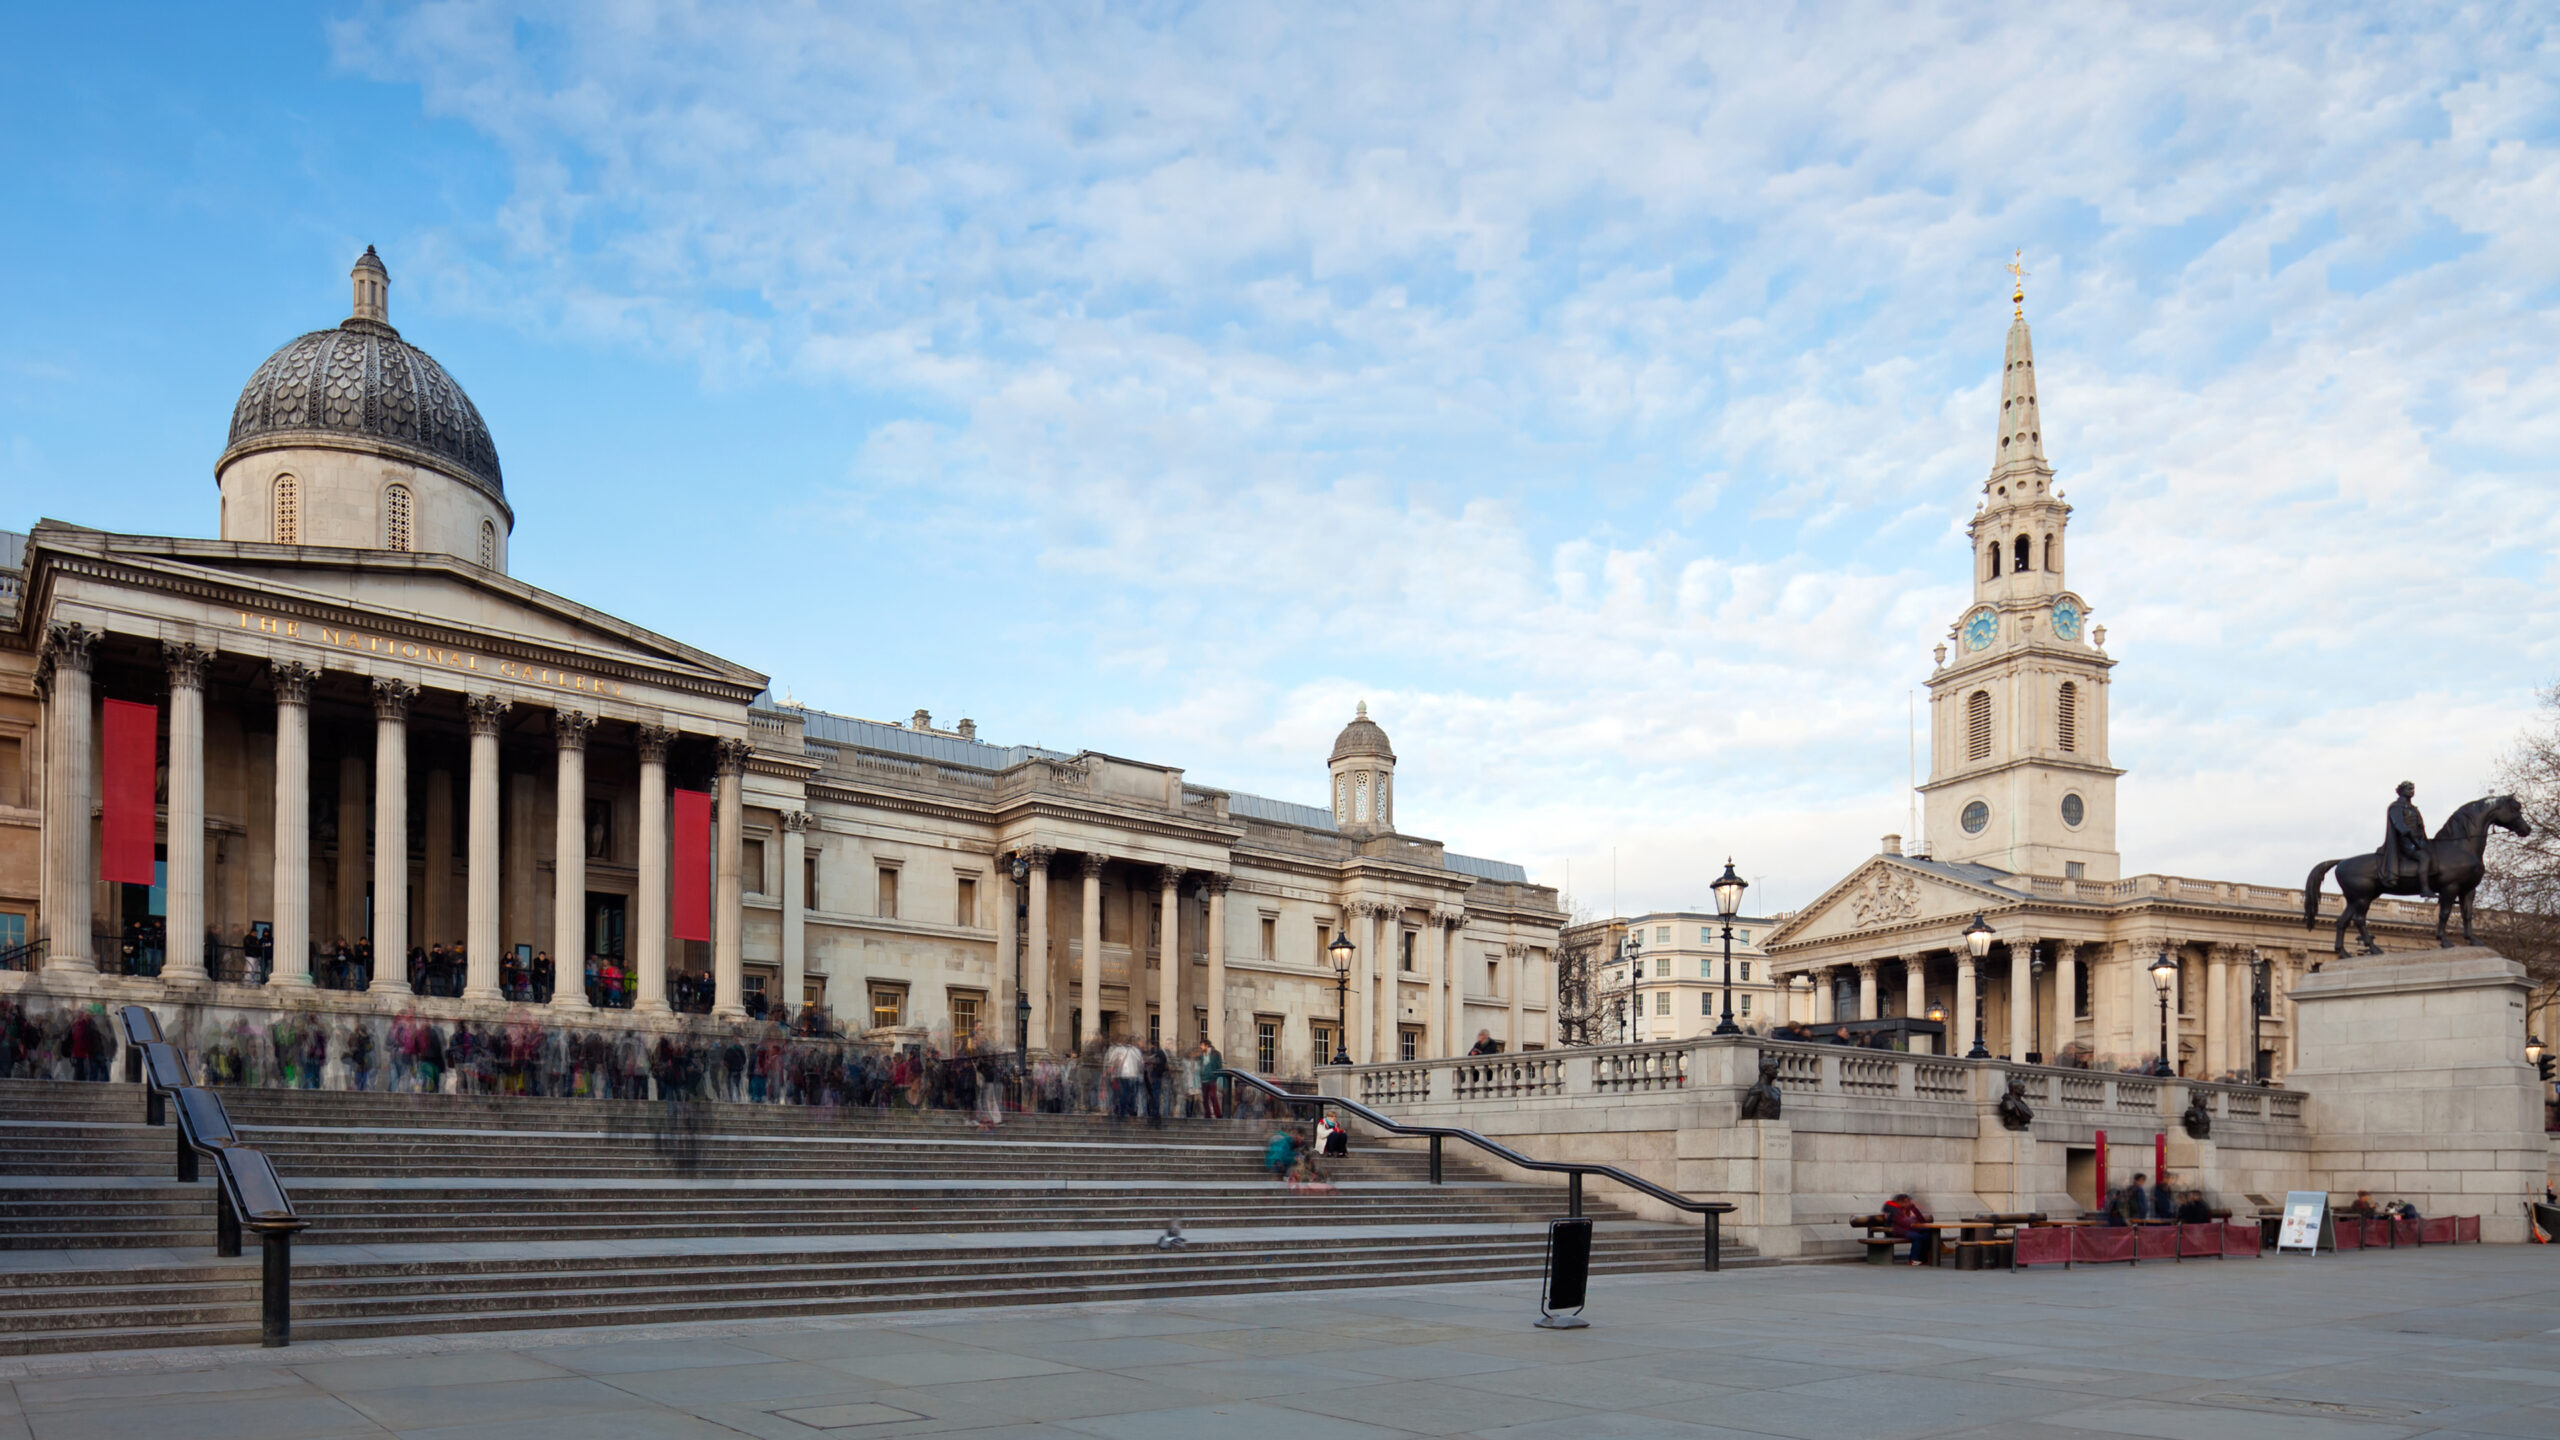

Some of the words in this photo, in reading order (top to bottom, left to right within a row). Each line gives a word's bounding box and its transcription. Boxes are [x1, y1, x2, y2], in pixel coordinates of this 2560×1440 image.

[235, 610, 299, 638] THE
[322, 627, 480, 671] NATIONAL
[501, 661, 624, 696] GALLERY
